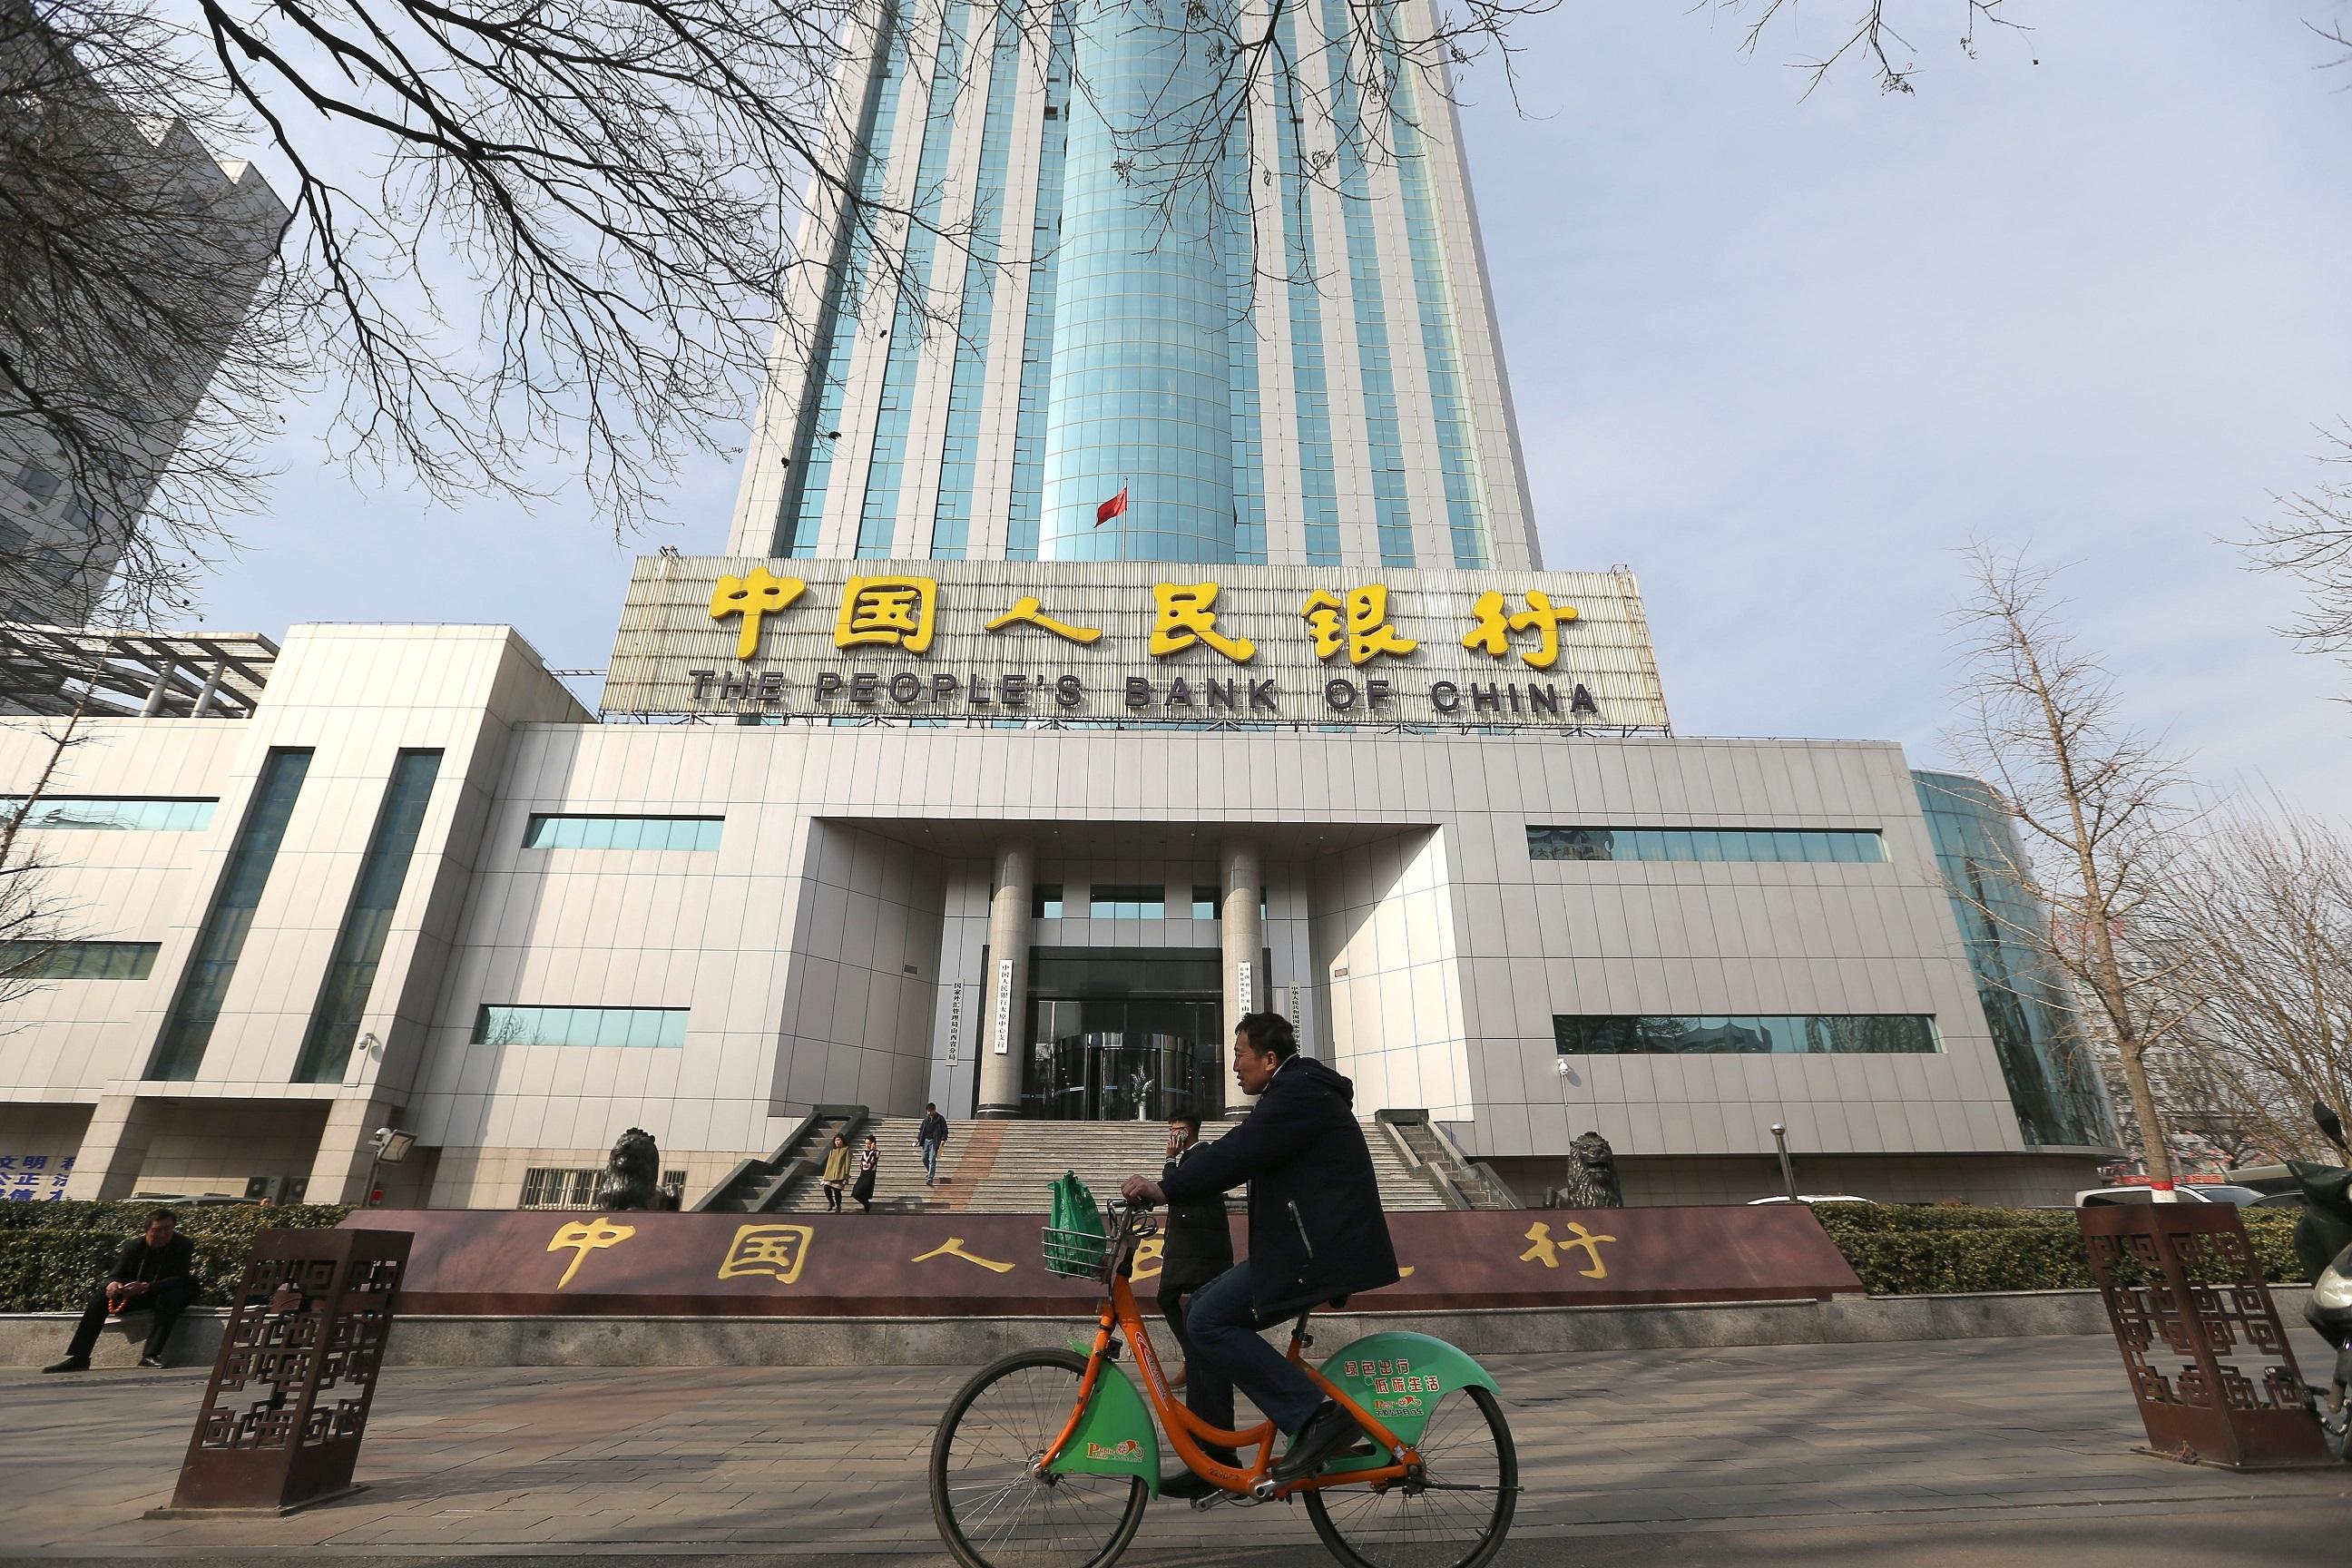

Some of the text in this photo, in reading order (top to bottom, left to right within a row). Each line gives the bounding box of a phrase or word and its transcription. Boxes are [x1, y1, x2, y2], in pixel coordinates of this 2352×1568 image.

[710, 566, 1579, 670] 中国人民银行
[689, 670, 1598, 714] THE PEOPLE'S BANK OF CHINA
[948, 982, 962, 1061] 国家外汇管理局山西省分局
[1344, 1358, 1410, 1377] 绿色出行
[1375, 1375, 1441, 1394] 低碳生活
